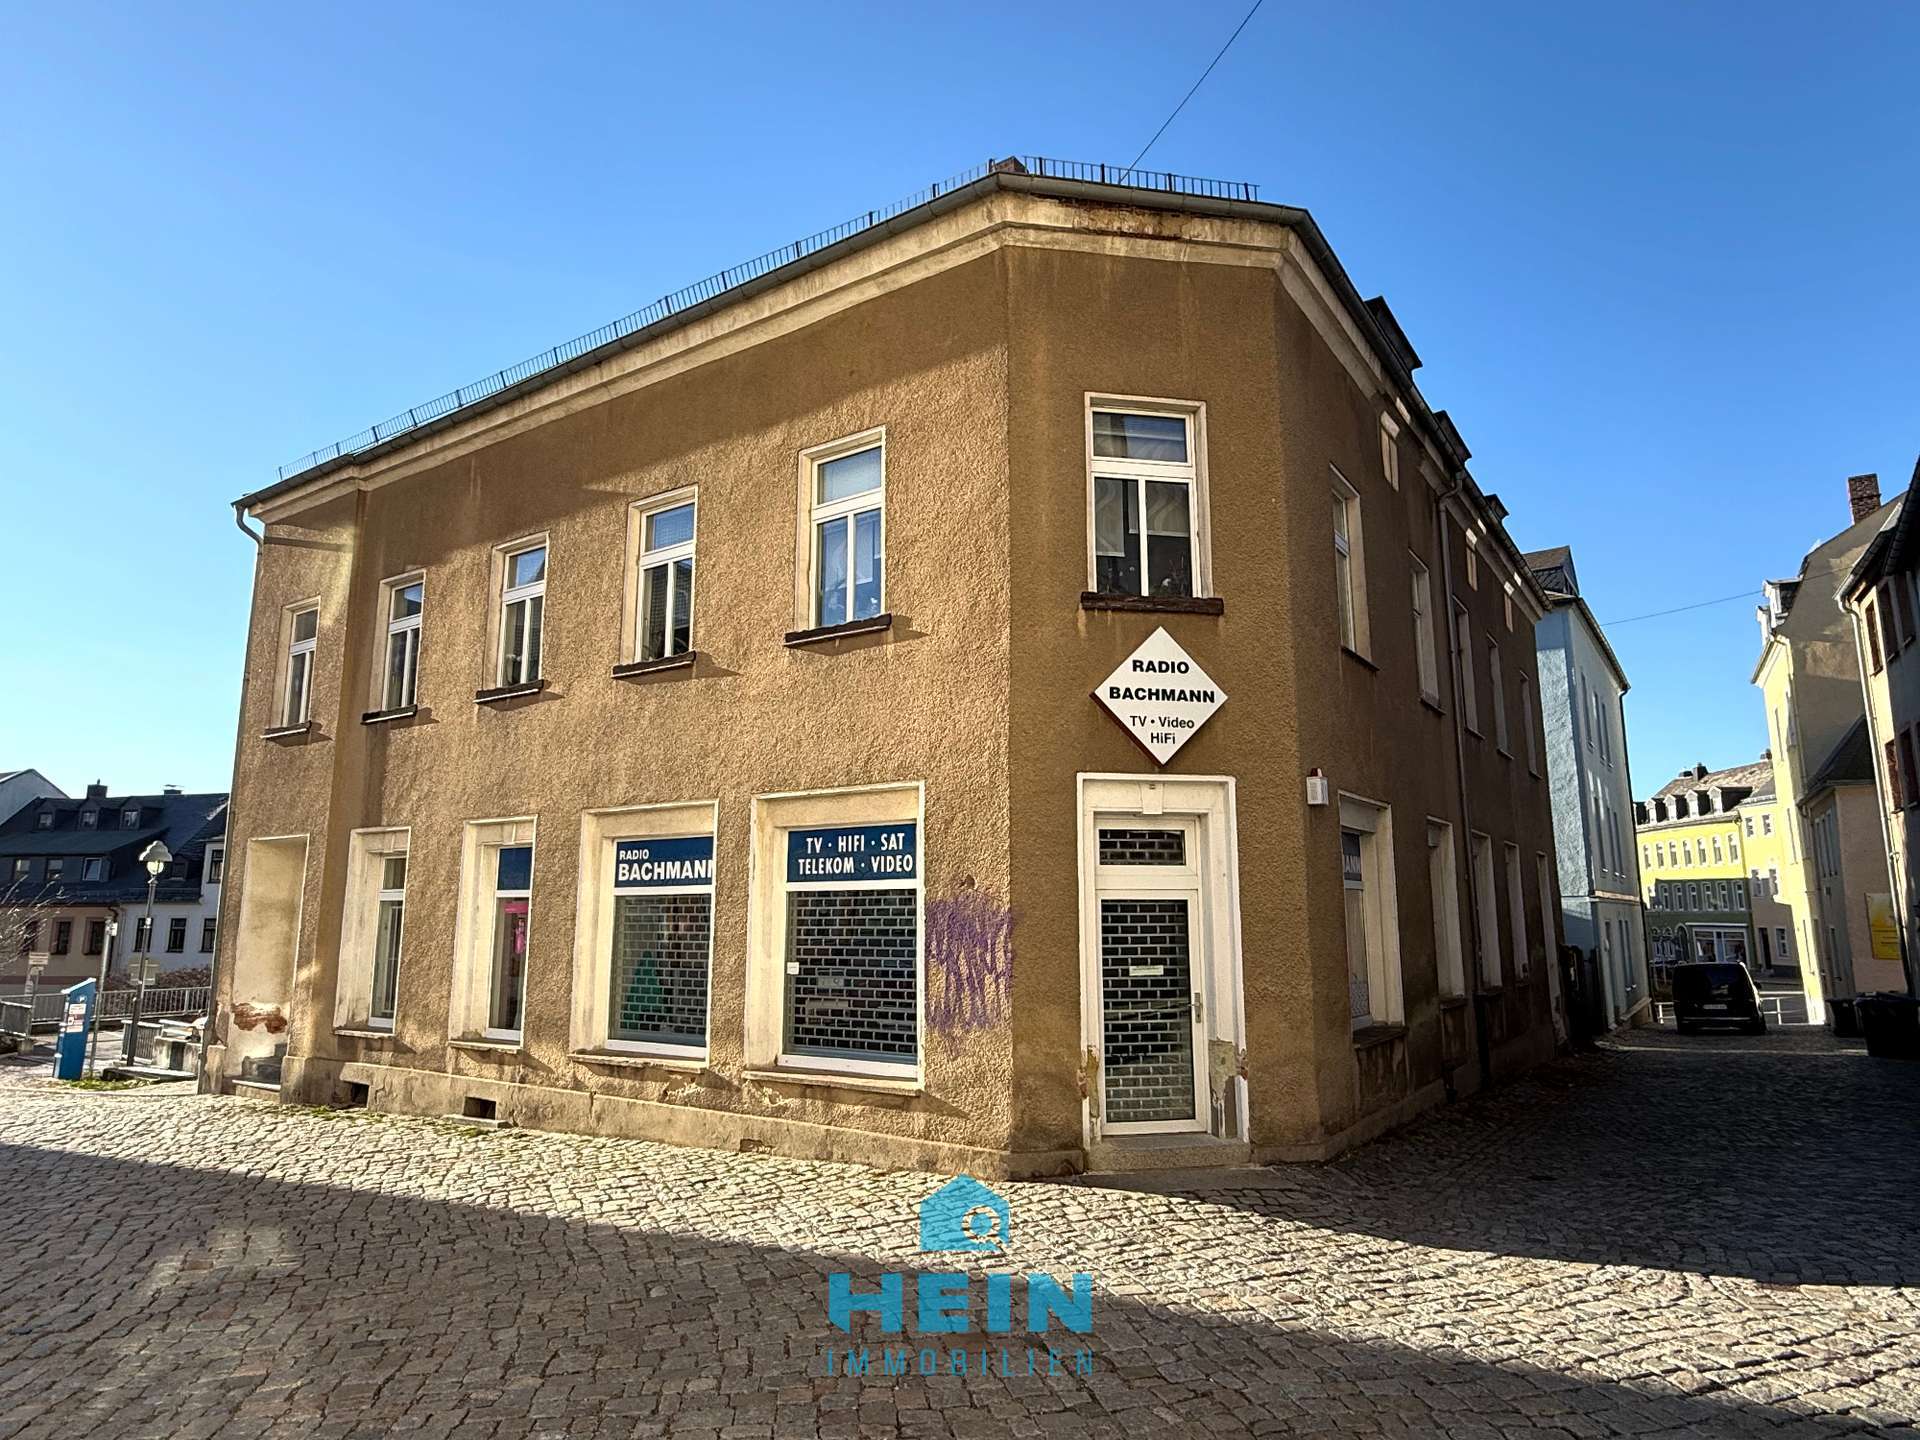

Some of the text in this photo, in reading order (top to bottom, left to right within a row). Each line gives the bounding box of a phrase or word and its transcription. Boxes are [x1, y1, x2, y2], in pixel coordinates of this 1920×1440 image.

[1132, 660, 1190, 674] RADIO
[1109, 686, 1215, 703] BACHMANN
[1130, 715, 1195, 729] TV Video
[1150, 732, 1176, 744] HiFi
[806, 832, 905, 854] TV HIFI SAT
[619, 849, 650, 860] RADIO
[798, 854, 914, 875] TELEKOM VIDEO
